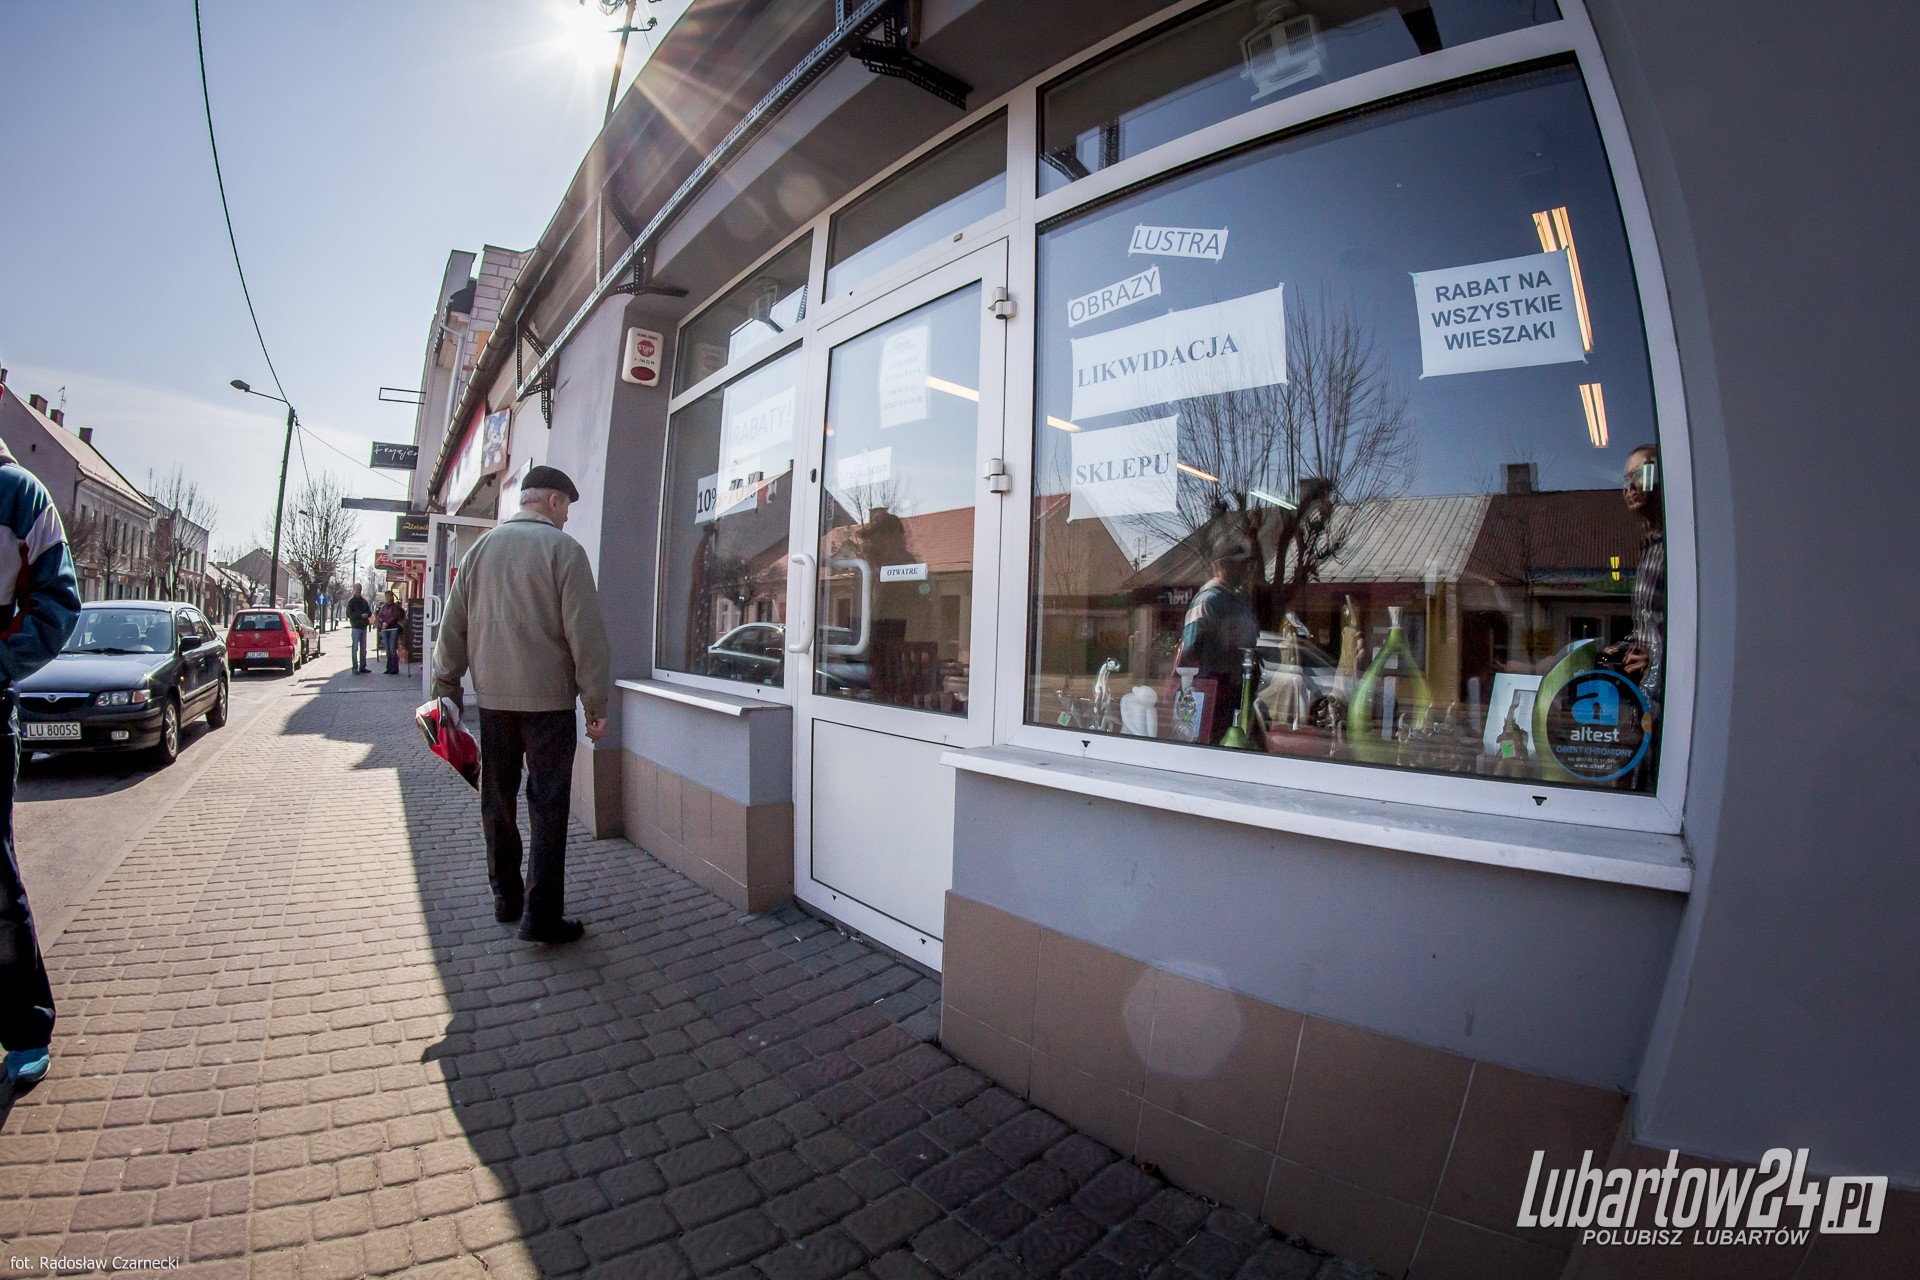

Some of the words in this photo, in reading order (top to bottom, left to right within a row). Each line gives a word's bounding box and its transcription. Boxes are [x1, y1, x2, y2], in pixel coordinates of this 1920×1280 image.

[1133, 229, 1219, 255] LUSTRA
[1071, 271, 1156, 321] OBRAZY
[1435, 275, 1511, 302] RABAT
[1518, 270, 1553, 290] NA
[1431, 293, 1563, 328] WSZYSTKIE
[1444, 321, 1556, 350] WIESZAKI
[1078, 333, 1240, 388] LIKWIDACJA
[732, 399, 792, 448] RABATY!
[1076, 453, 1170, 485] SKLEPU
[886, 567, 919, 577] OTWATRE
[29, 724, 44, 737] LU
[47, 724, 79, 737] 8005S
[1570, 726, 1620, 742] altest
[1555, 745, 1583, 753] OBIEKT
[1584, 746, 1633, 757] CHRONIONY
